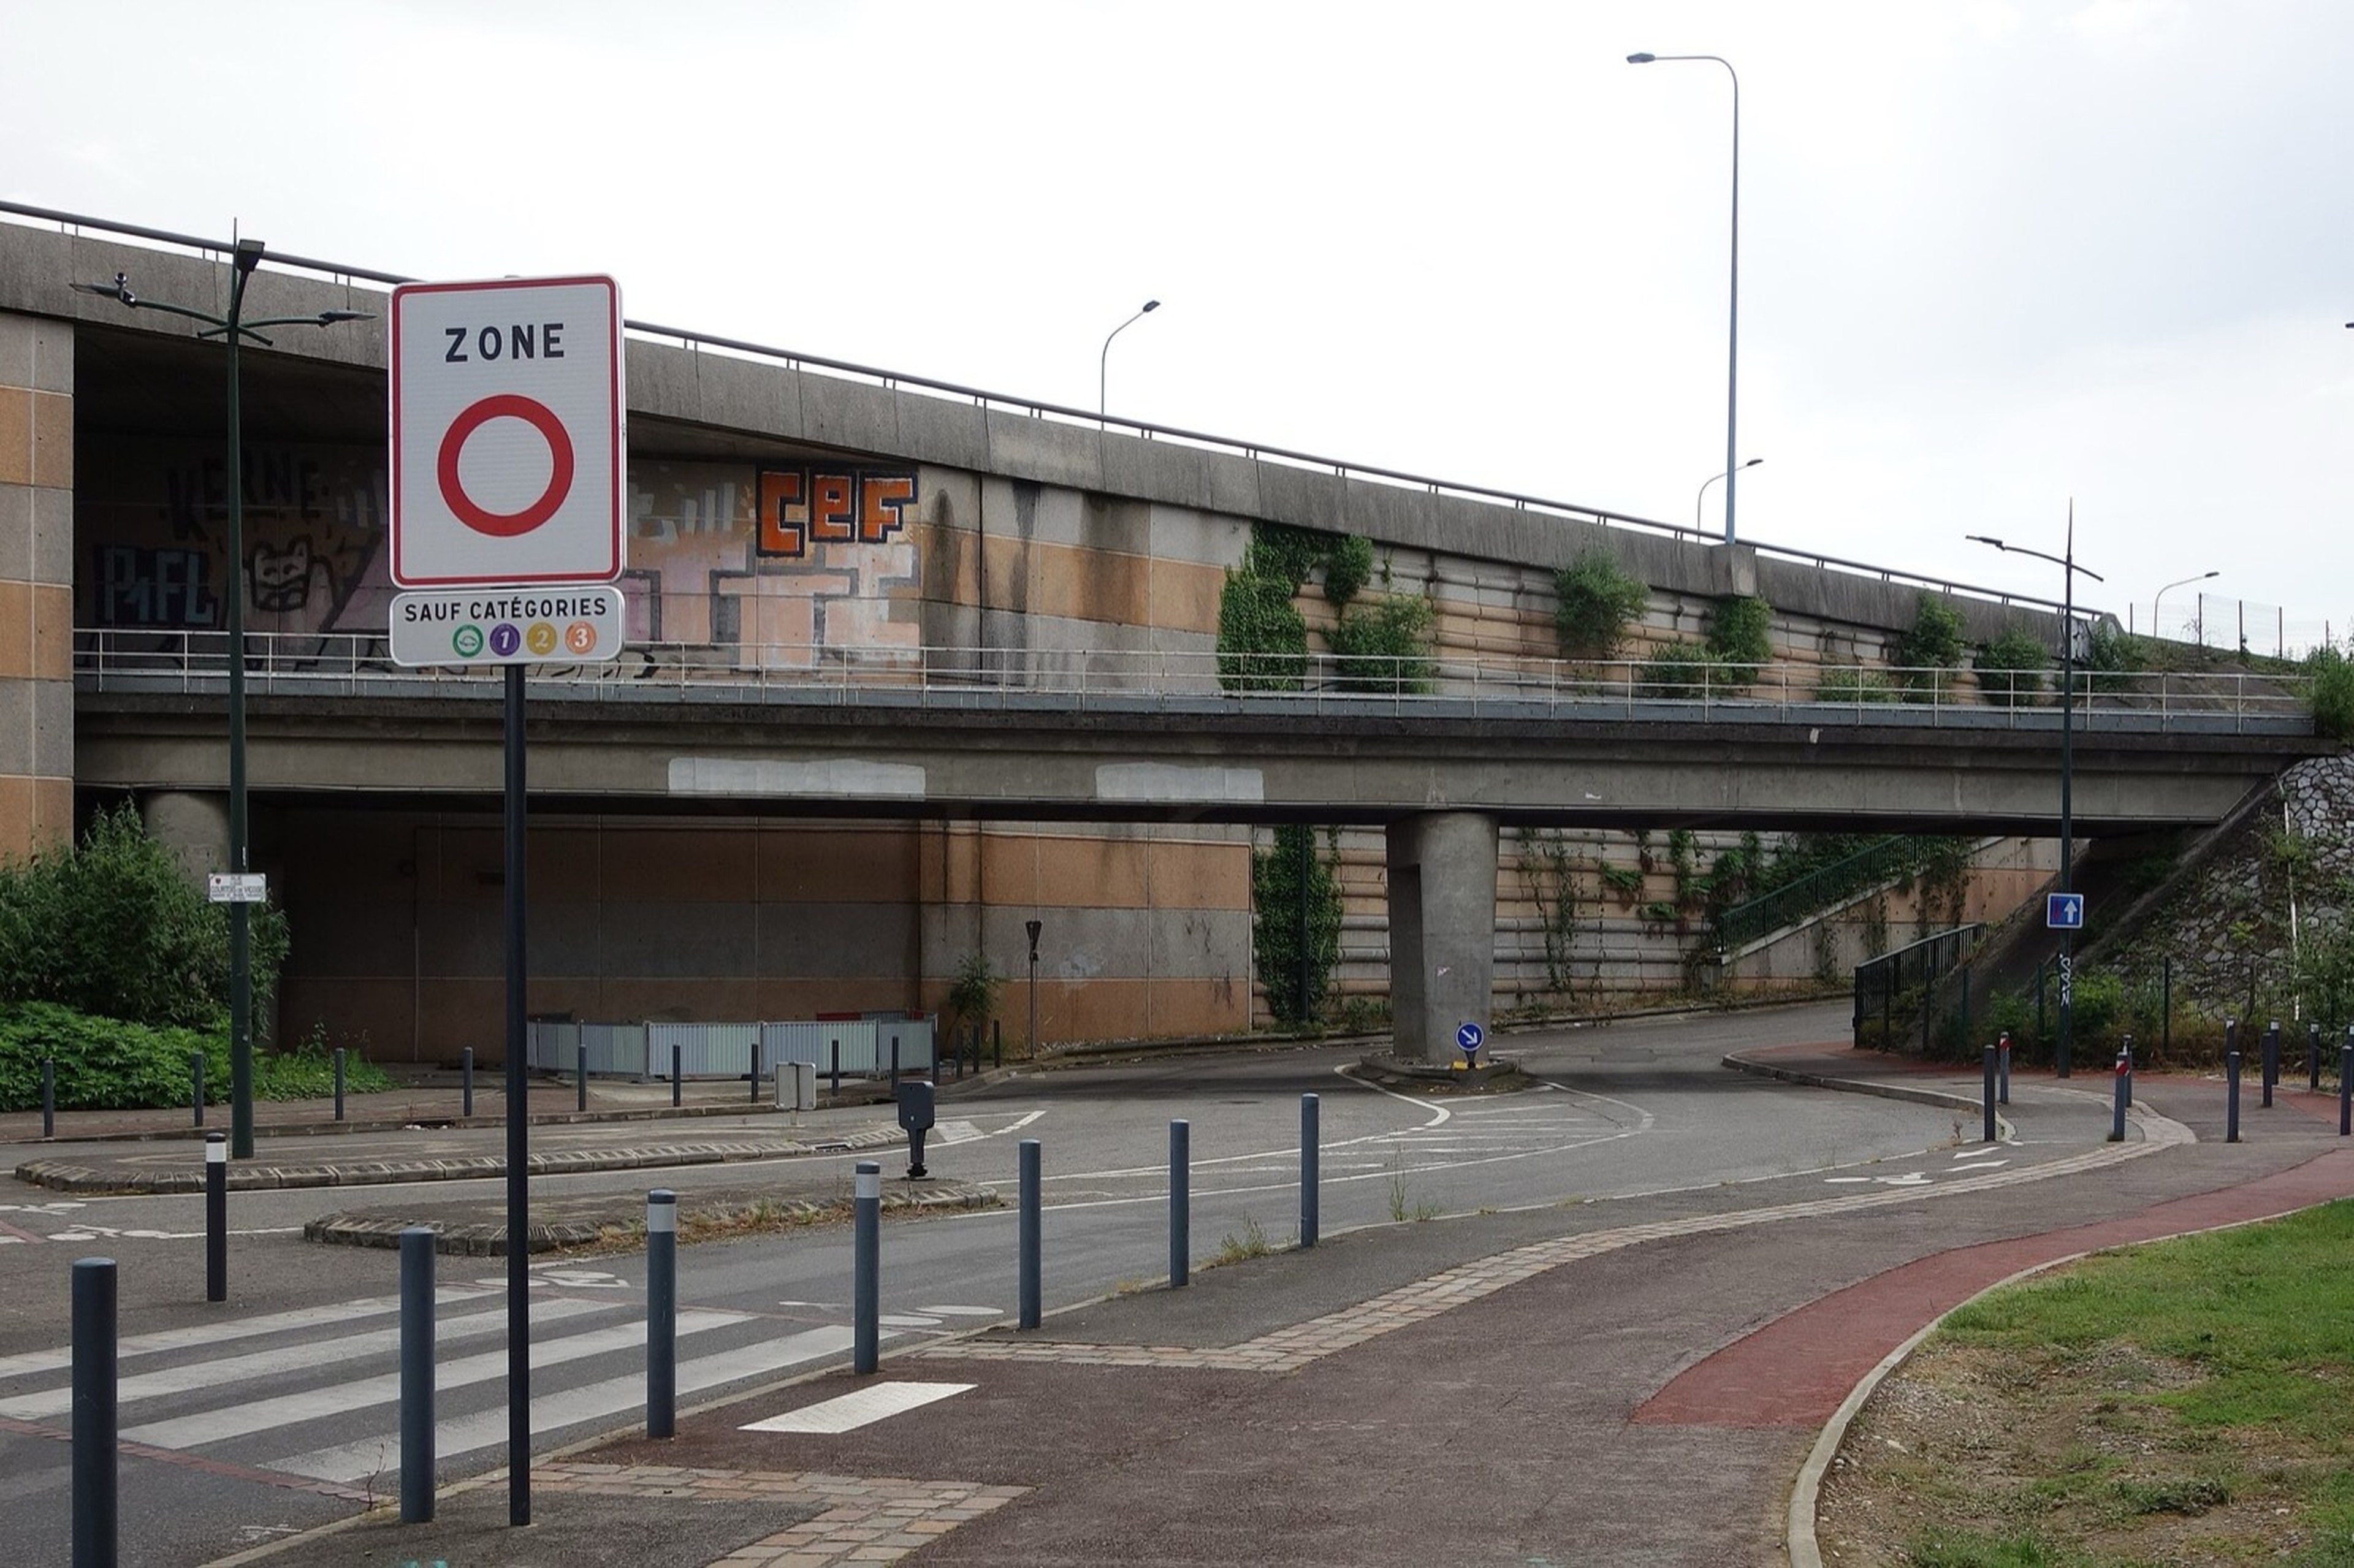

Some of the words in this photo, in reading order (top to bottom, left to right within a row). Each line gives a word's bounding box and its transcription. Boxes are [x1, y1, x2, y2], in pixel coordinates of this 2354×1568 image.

[445, 323, 565, 362] ZONE
[405, 603, 462, 622] SAUF
[470, 596, 606, 620] CATÉGORIES
[501, 631, 510, 649] 1
[536, 630, 549, 648] 2
[574, 628, 588, 648] 3
